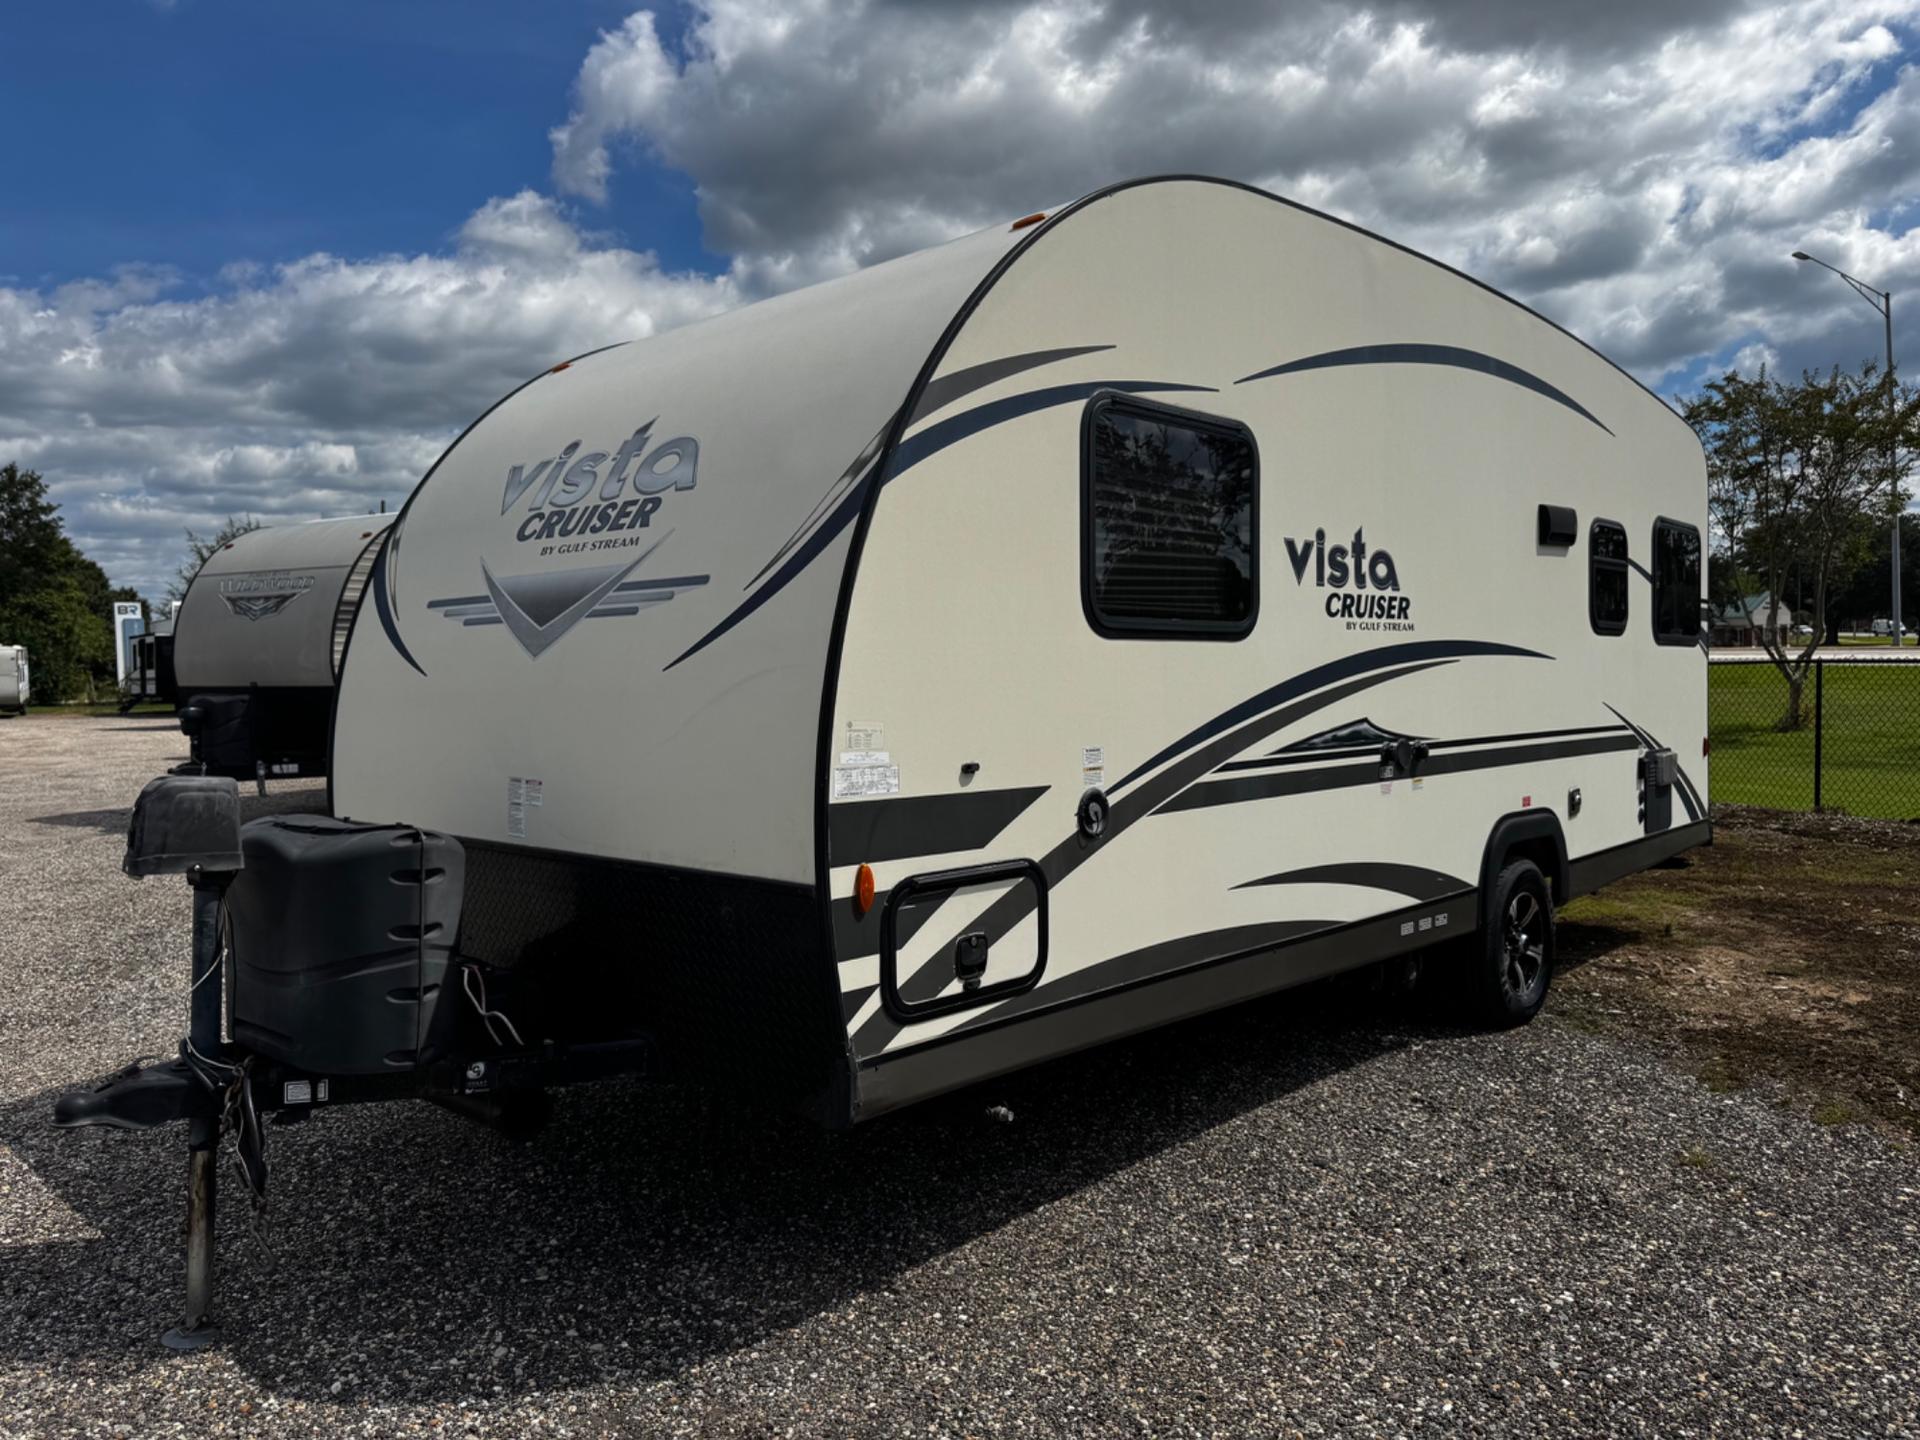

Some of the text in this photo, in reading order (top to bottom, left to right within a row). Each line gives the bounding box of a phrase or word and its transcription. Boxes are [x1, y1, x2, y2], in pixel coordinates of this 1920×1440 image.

[501, 415, 701, 517] vista
[516, 496, 662, 542] CRUISER
[540, 536, 640, 557] BY GULF STREAM
[1283, 525, 1400, 592] vista
[117, 605, 138, 615] BR
[1325, 592, 1411, 620] CRUISER
[1346, 622, 1415, 632] BY GULF STREAM
